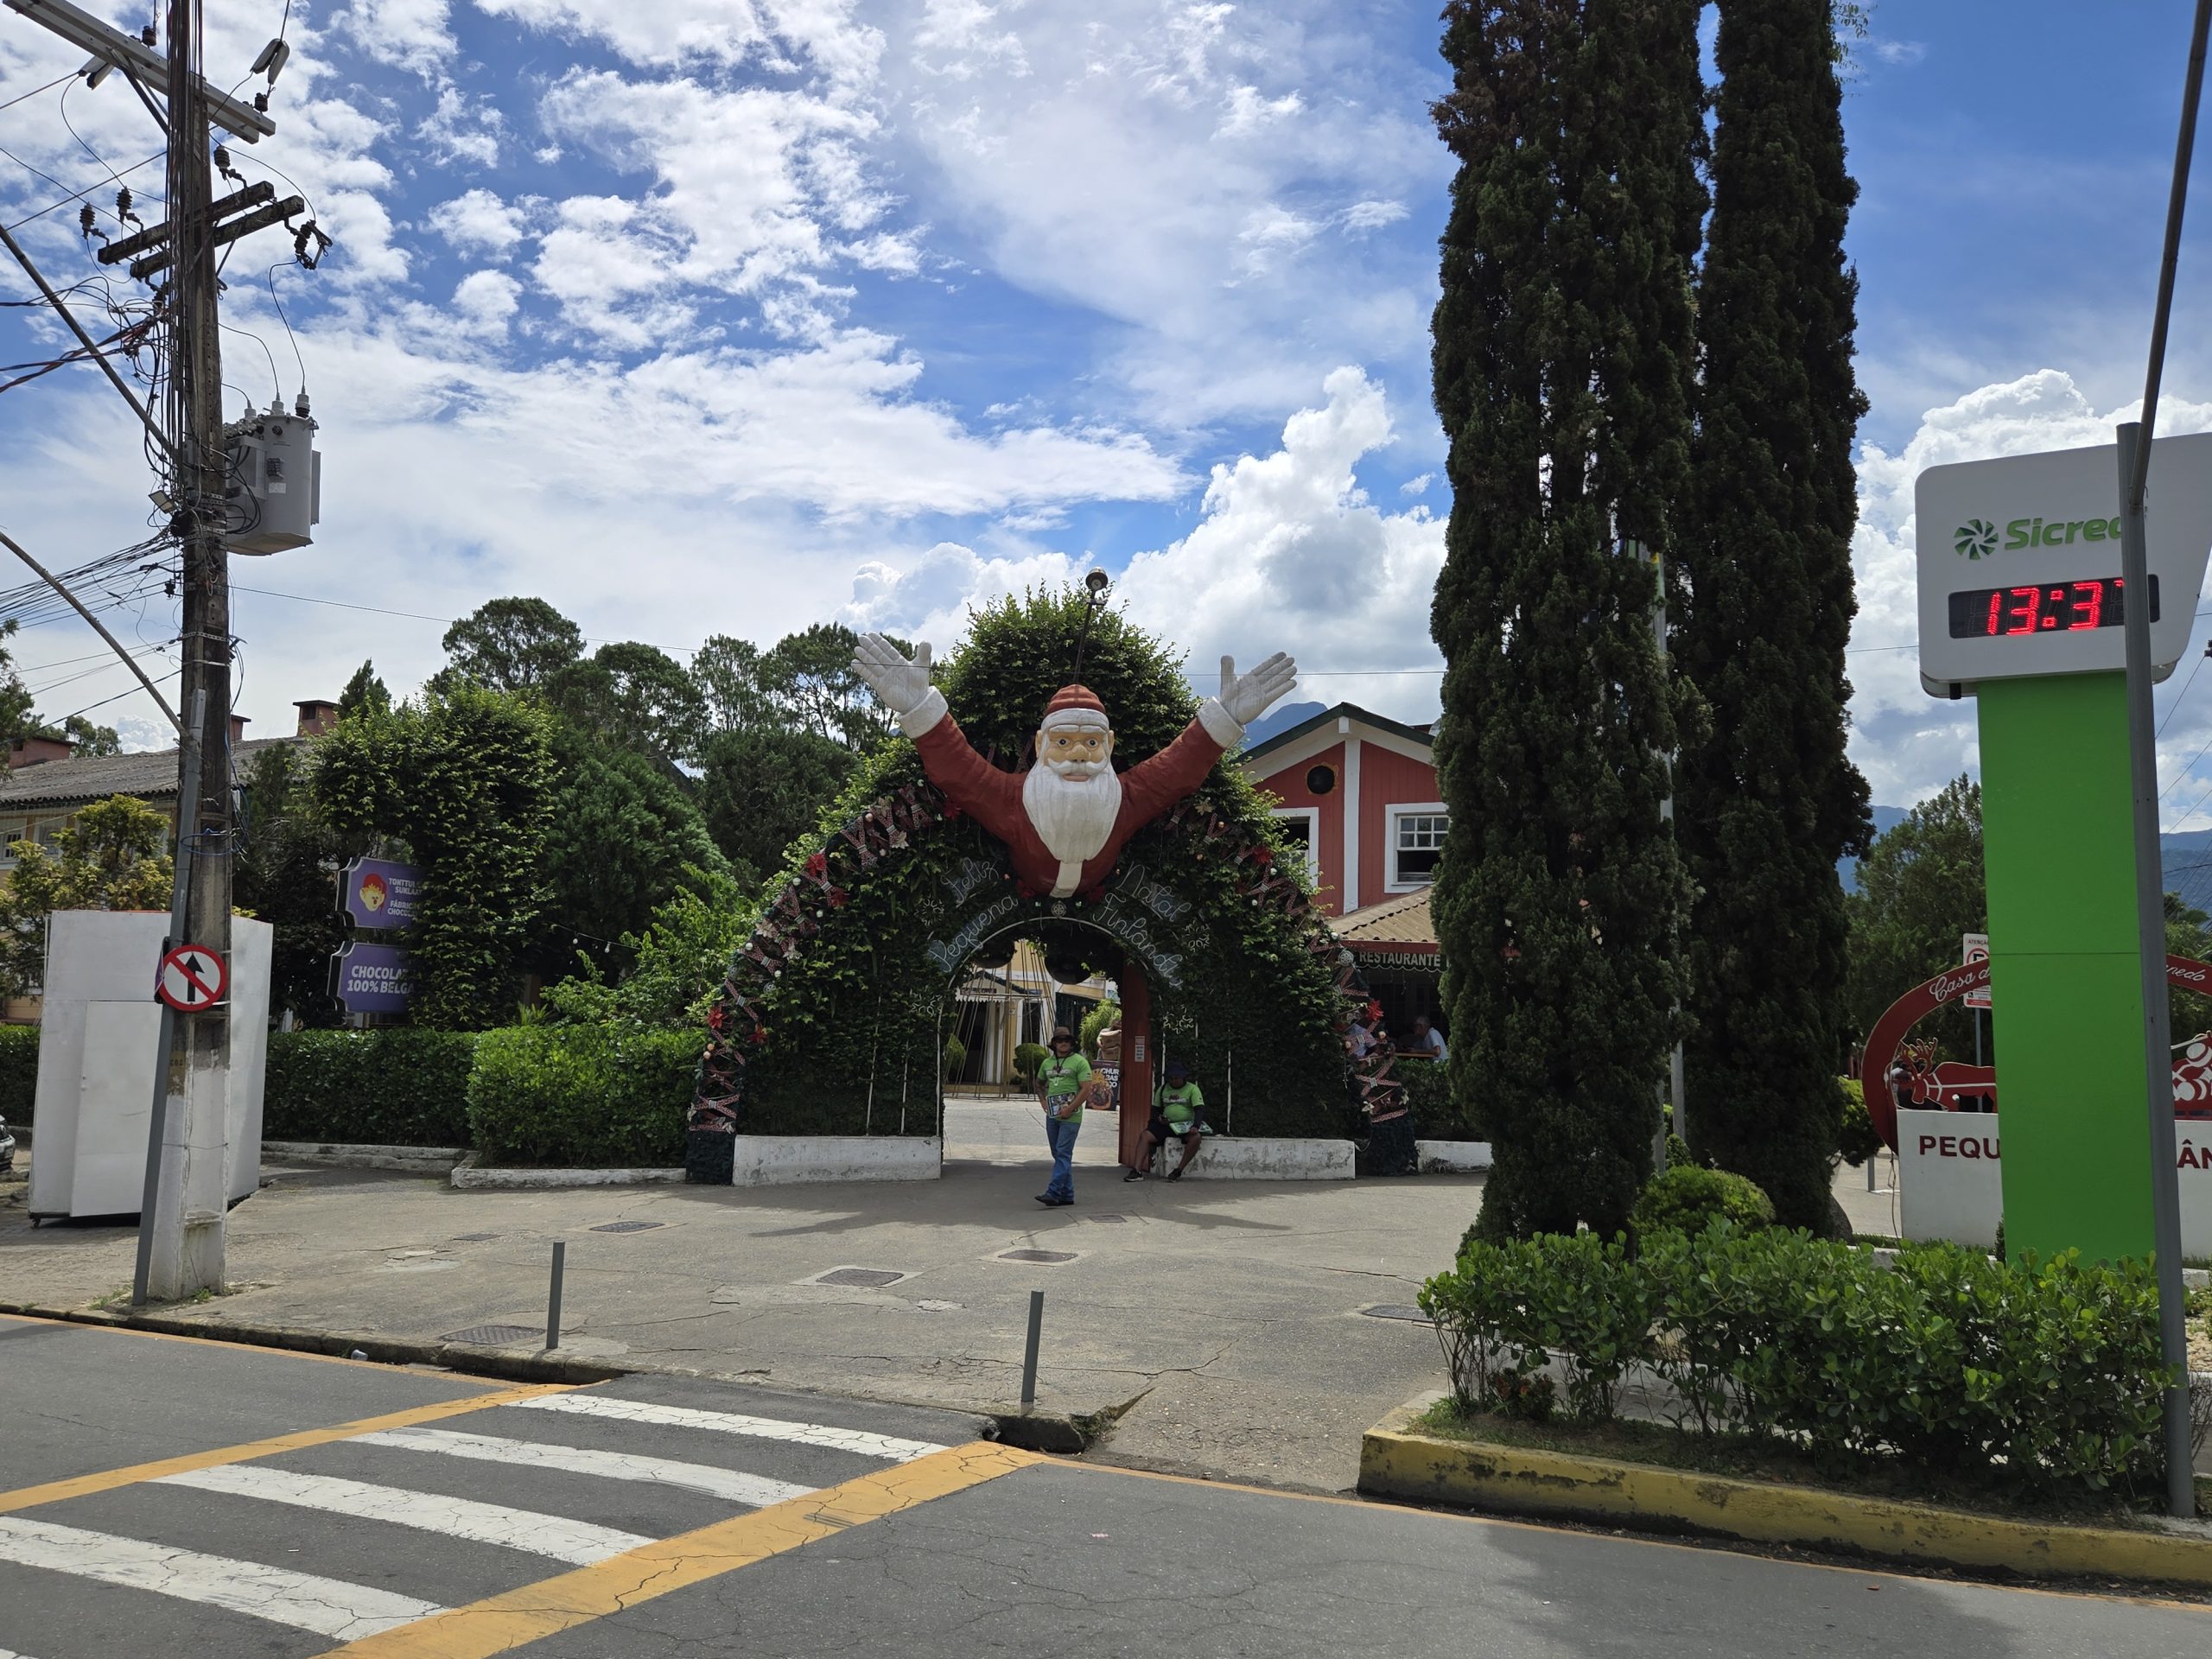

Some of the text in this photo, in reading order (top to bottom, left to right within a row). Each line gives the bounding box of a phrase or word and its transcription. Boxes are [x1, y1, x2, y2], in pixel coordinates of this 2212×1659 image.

[1987, 577, 2125, 637] 13:3
[940, 857, 1192, 923] Feliz Natal
[927, 894, 1019, 973] Pequena
[1359, 951, 1441, 967] RESTAURANTE
[347, 979, 416, 995] 100% BELGA
[1929, 972, 1976, 1002] Casa
[2165, 965, 2206, 982] nedo
[1919, 1135, 2212, 1170] PEQU ÂN
